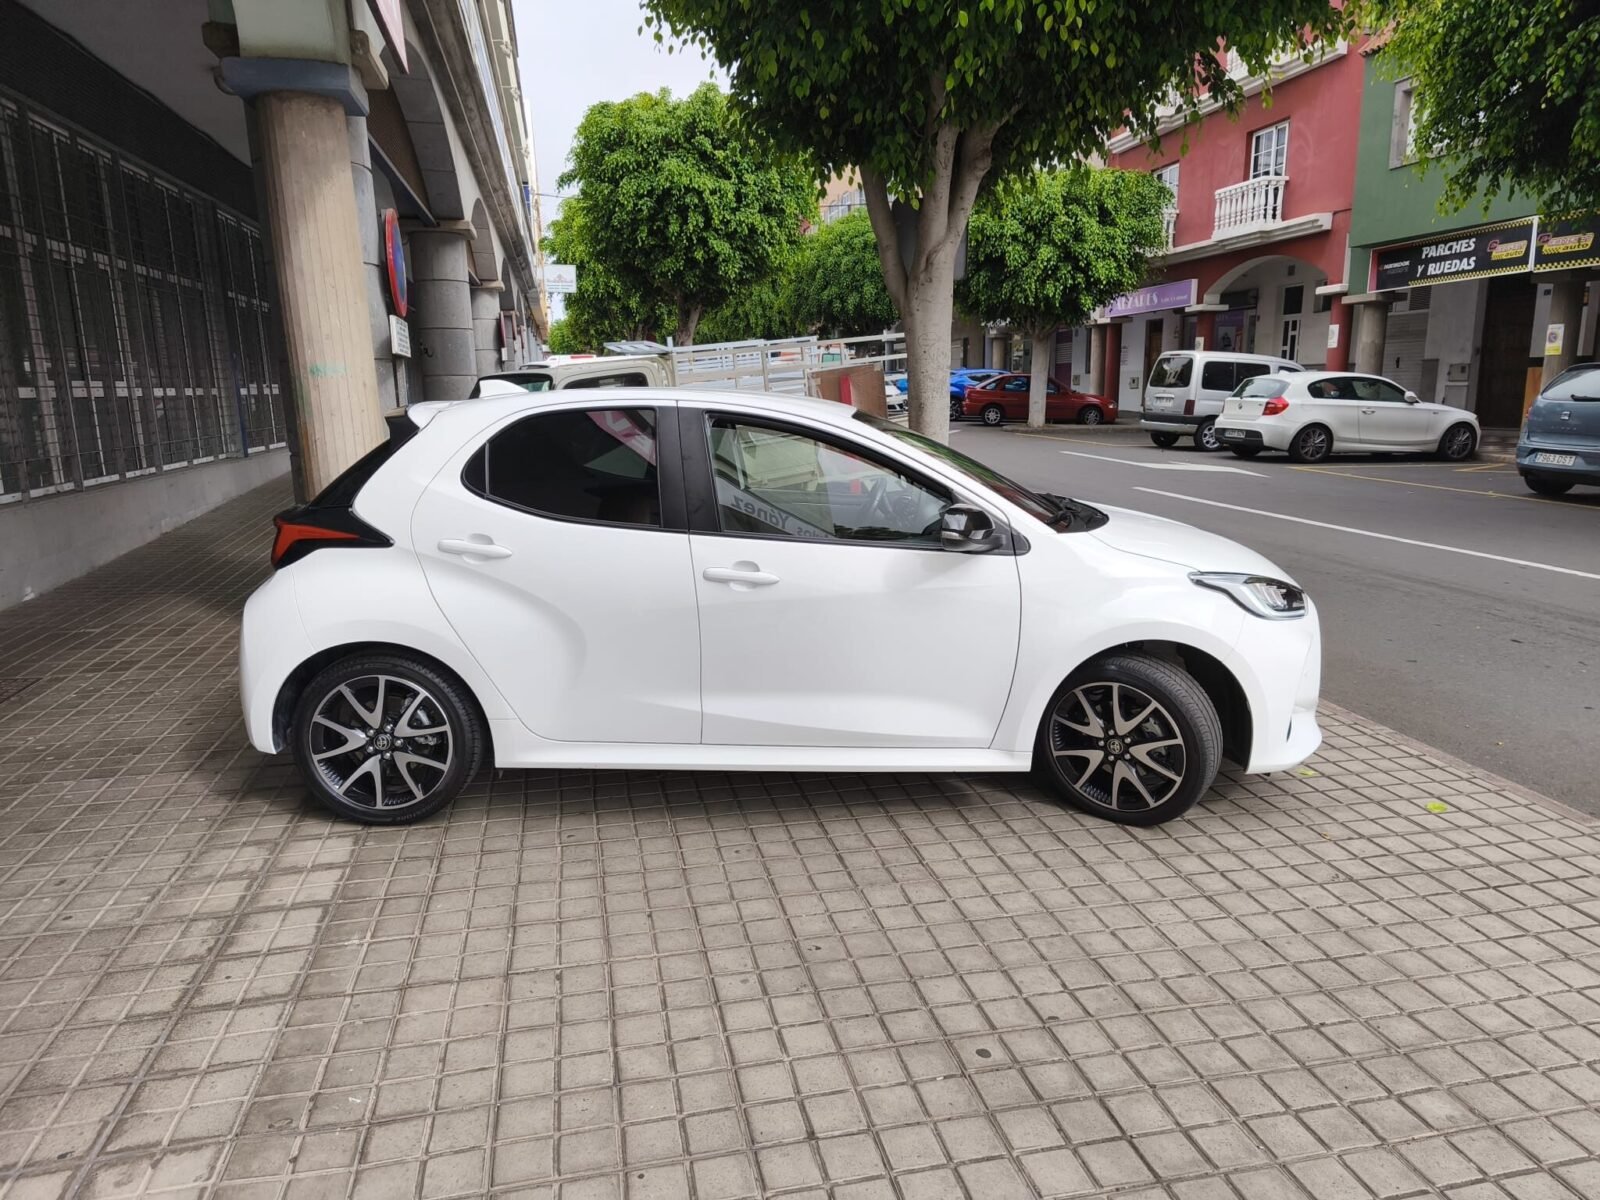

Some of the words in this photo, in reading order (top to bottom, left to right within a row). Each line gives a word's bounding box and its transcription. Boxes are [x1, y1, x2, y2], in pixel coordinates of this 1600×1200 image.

[1421, 238, 1476, 260] PARCHES
[1504, 249, 1523, 258] auto
[1562, 242, 1589, 251] auto
[1416, 264, 1425, 278] Y
[1427, 256, 1476, 276] RUEDAS
